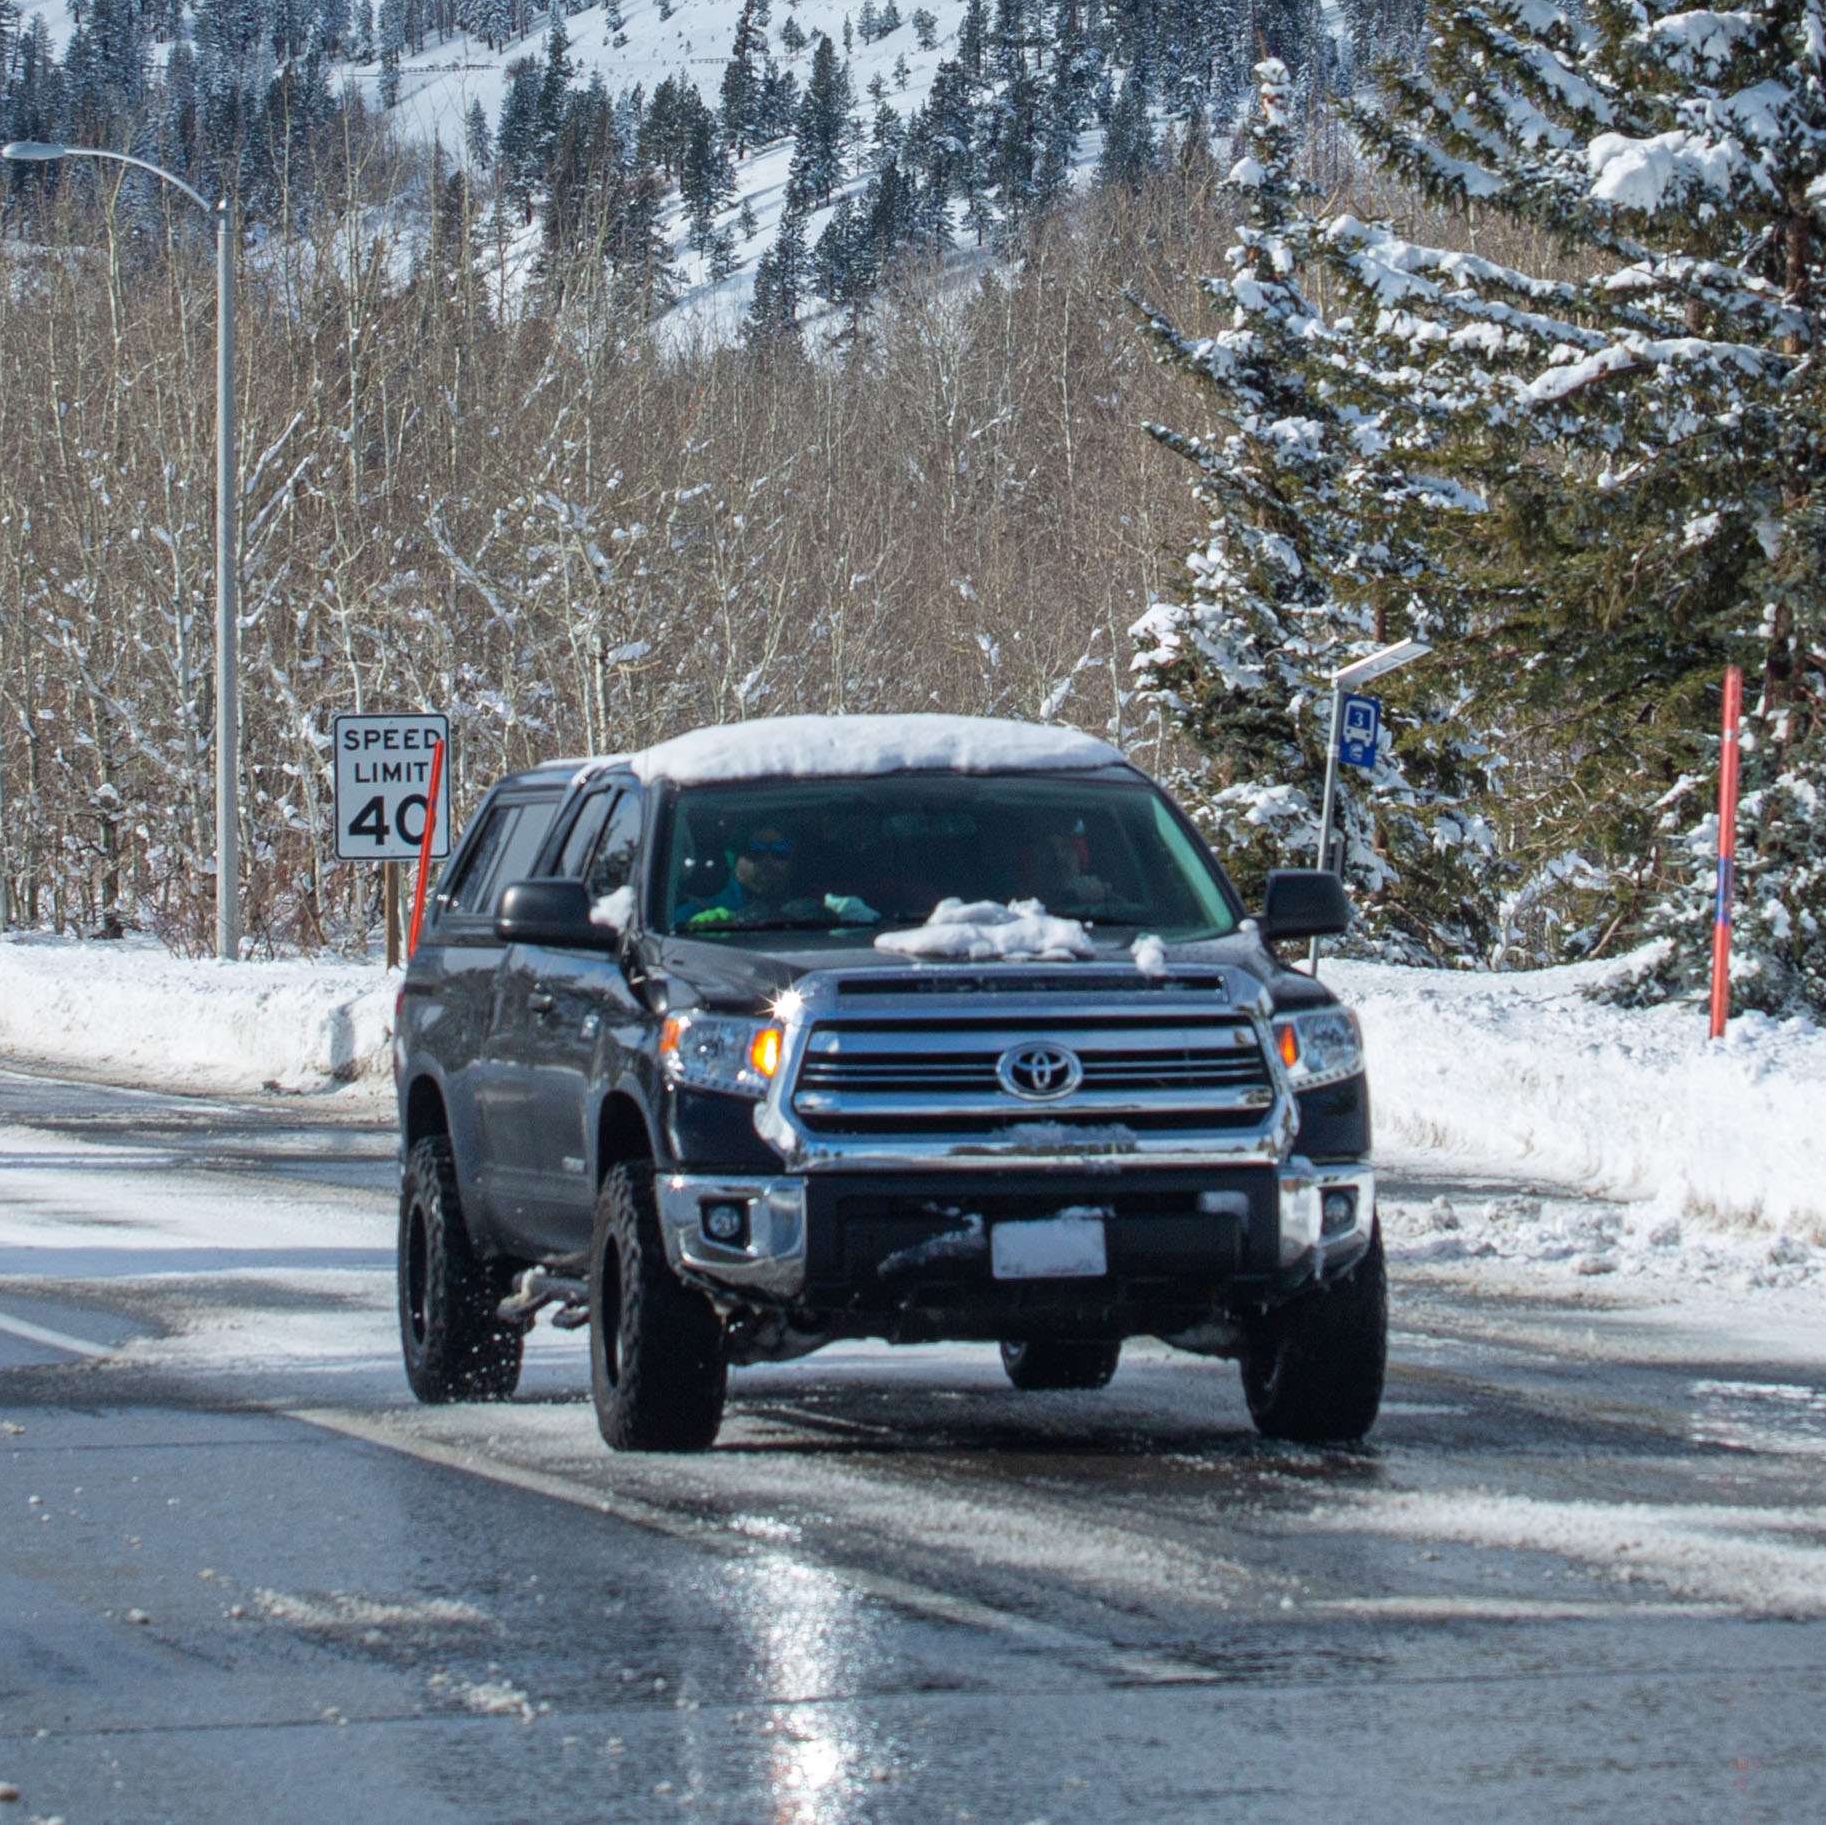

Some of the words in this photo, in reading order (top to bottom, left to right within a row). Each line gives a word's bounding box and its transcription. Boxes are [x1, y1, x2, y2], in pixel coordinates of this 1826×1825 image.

[1354, 711, 1364, 727] 3
[344, 729, 441, 751] SPEED
[355, 762, 429, 783] LIMIT
[348, 793, 430, 846] 40
